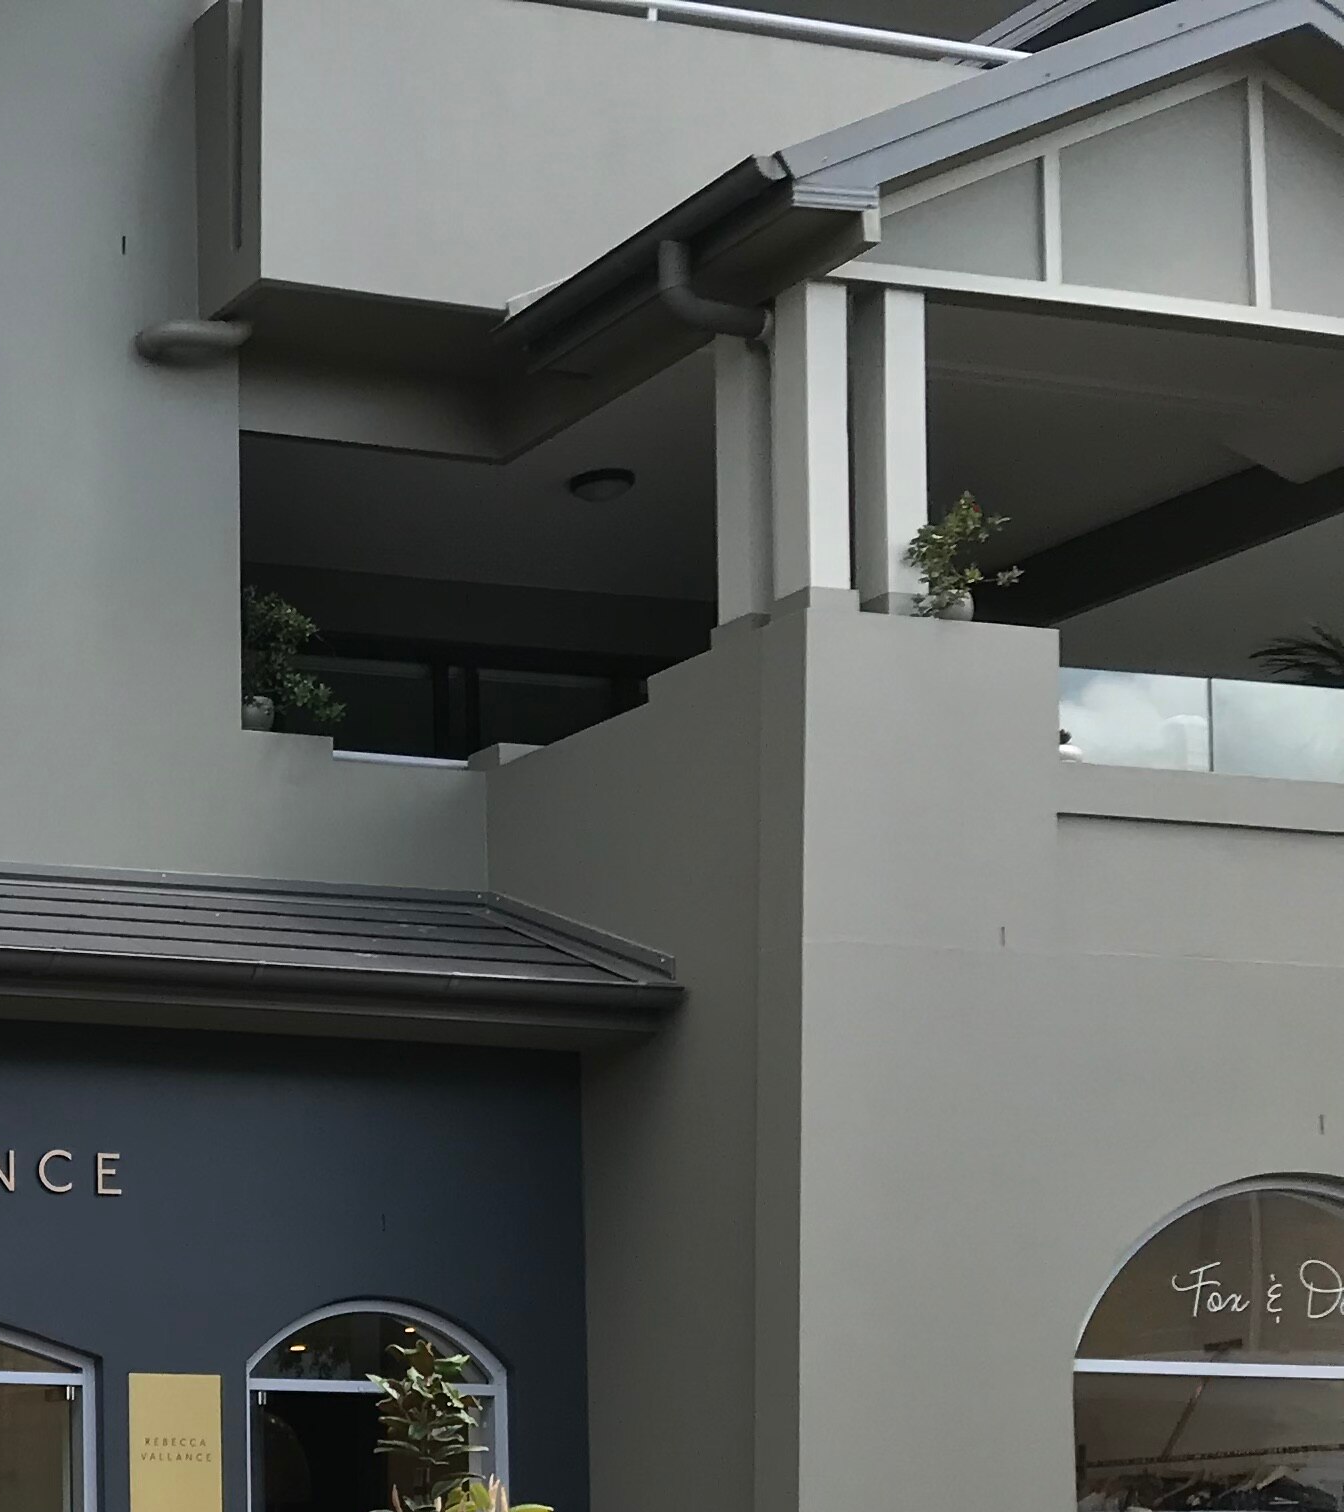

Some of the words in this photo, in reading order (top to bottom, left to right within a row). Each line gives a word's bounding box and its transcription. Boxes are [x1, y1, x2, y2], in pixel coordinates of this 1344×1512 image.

[1171, 1261, 1250, 1318] Fox
[143, 1436, 207, 1448] REBECCA
[140, 1451, 213, 1463] VALLANCE
